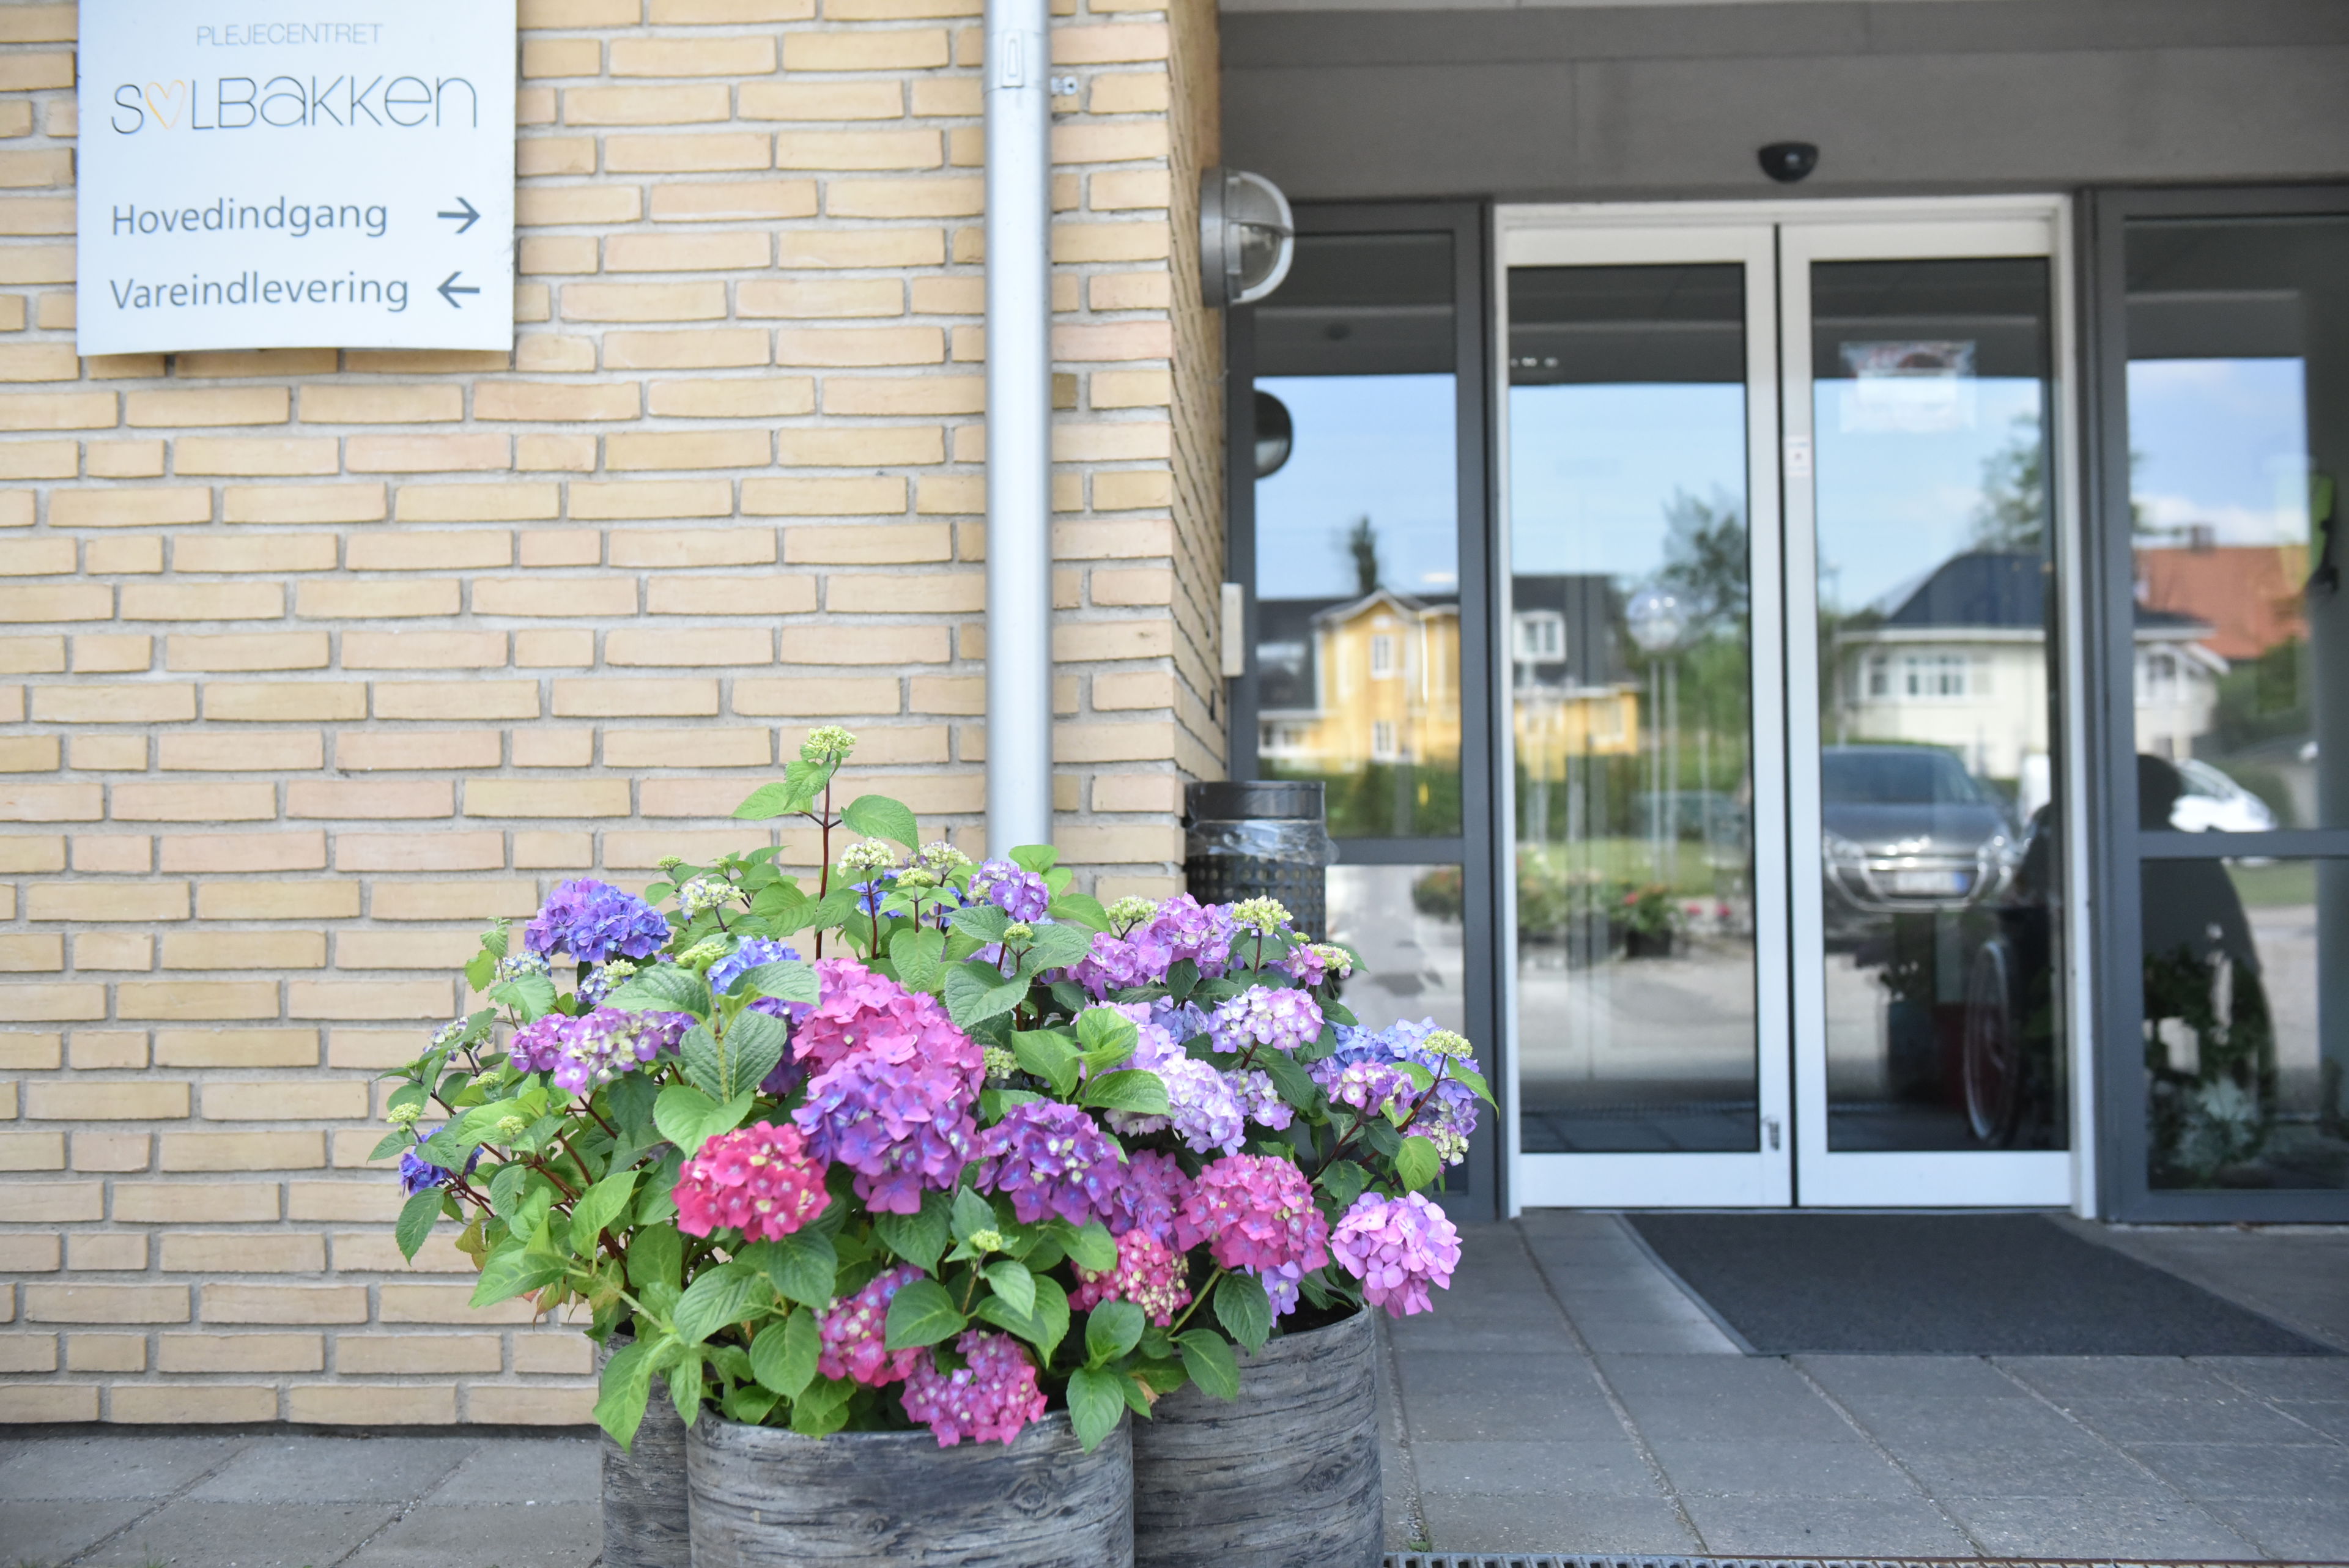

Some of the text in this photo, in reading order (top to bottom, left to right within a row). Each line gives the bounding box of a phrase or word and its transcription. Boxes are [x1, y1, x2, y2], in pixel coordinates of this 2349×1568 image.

[196, 22, 384, 46] PLEJECENTRET
[112, 196, 388, 237] Hovedindgang
[109, 271, 409, 312] Vareindlevering
